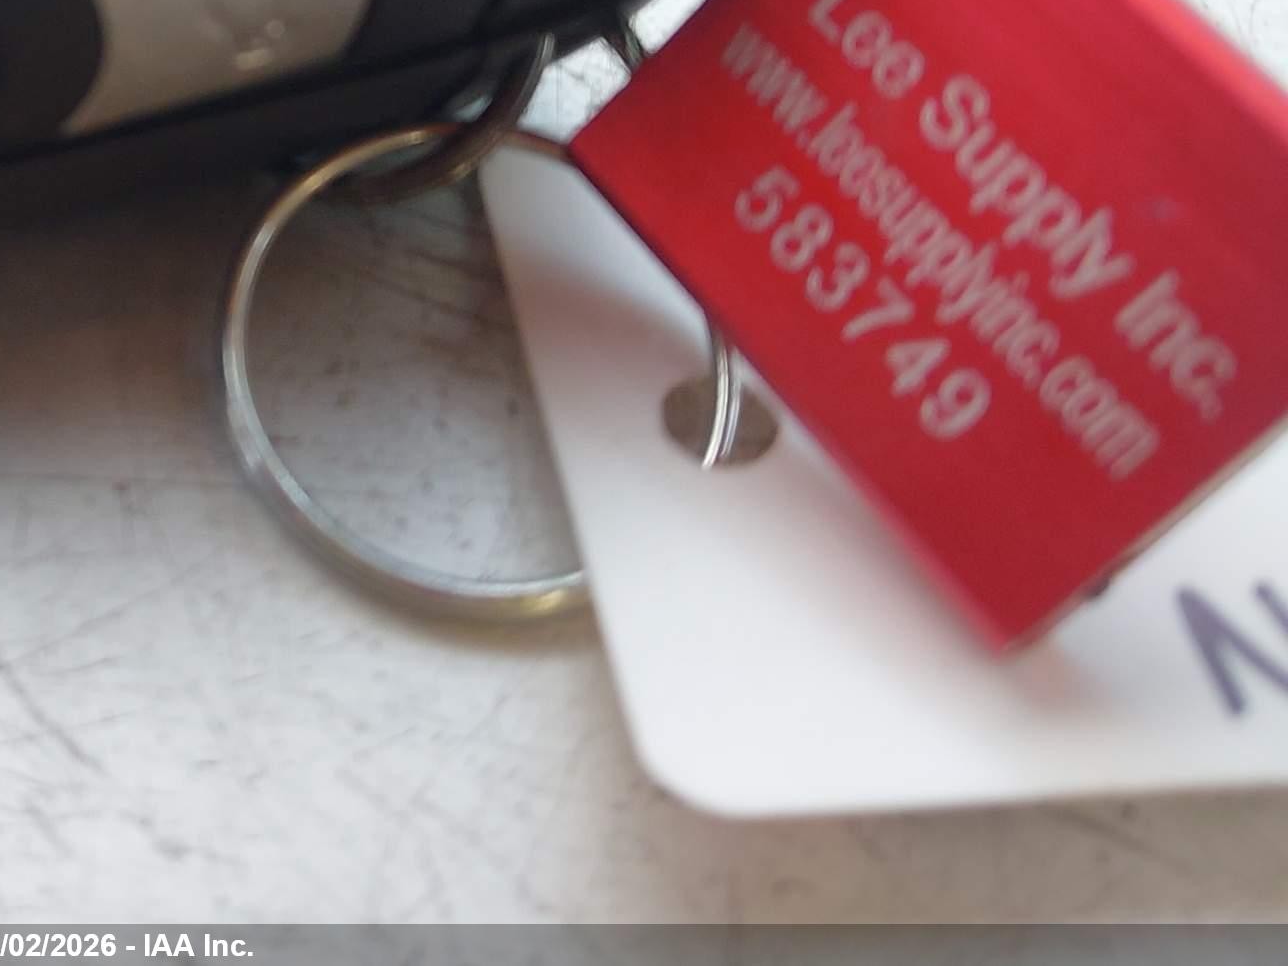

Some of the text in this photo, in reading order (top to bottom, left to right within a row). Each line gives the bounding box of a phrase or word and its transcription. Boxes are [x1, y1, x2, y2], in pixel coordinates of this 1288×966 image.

[734, 167, 991, 439] 583749
[919, 75, 1136, 299] Supply
[1115, 270, 1237, 422] Inc.
